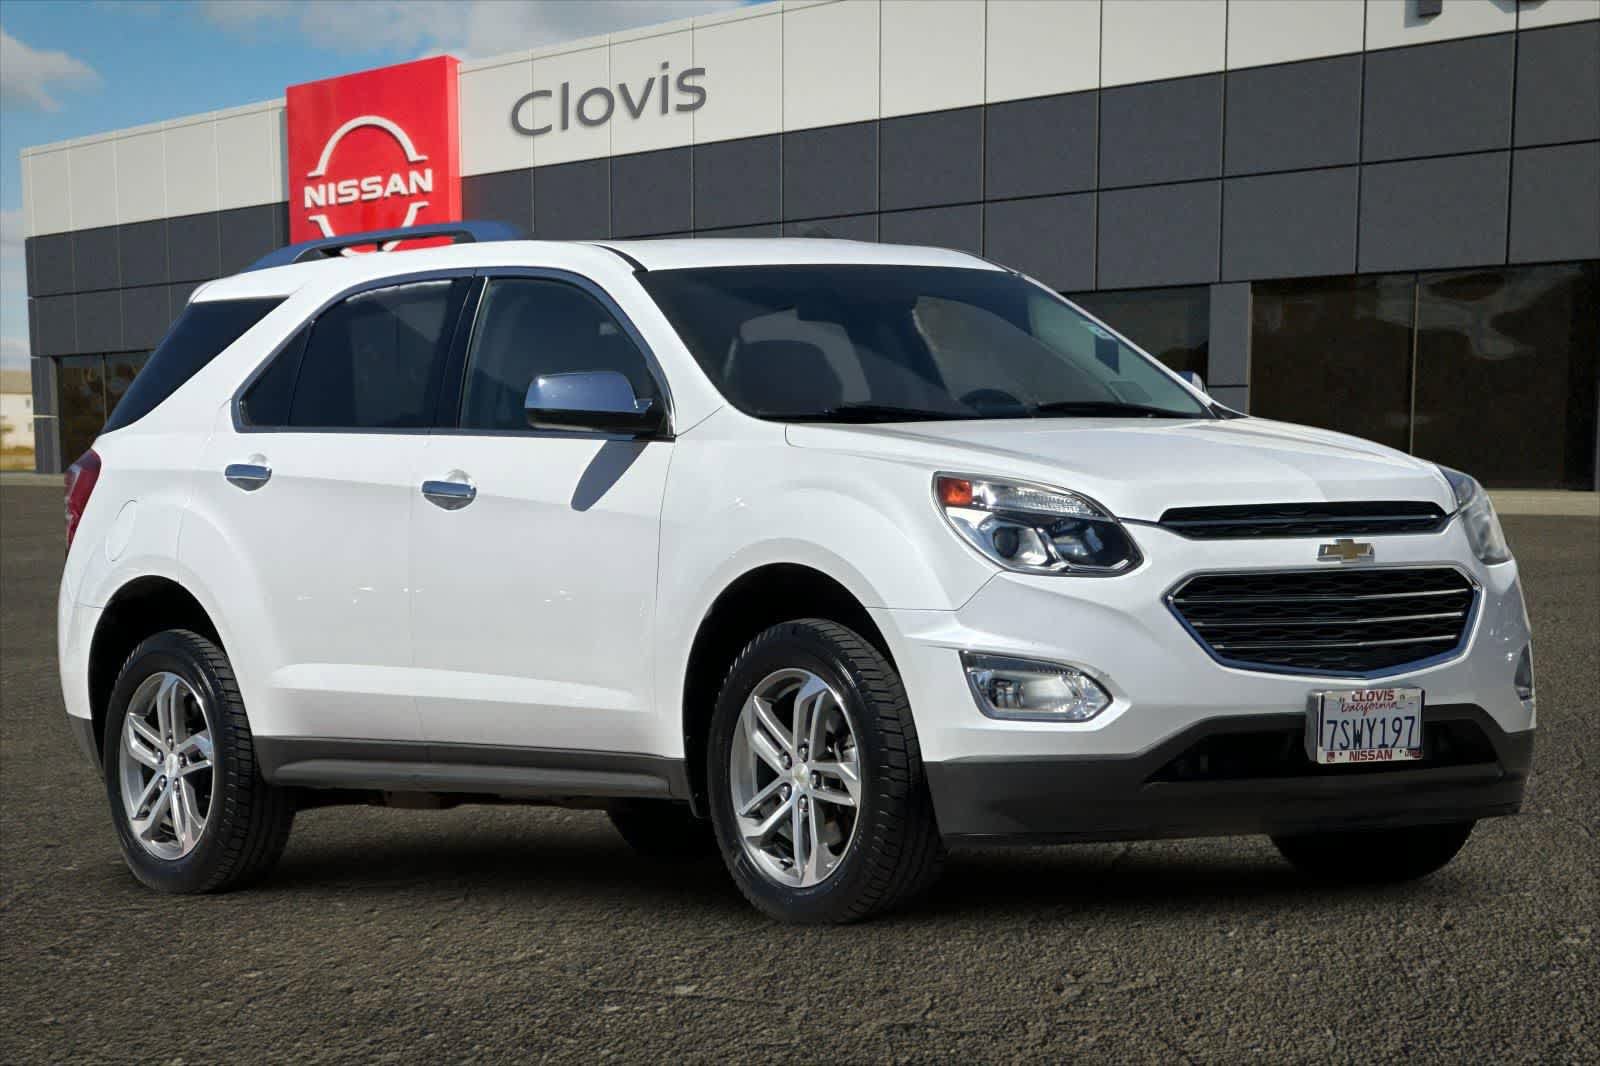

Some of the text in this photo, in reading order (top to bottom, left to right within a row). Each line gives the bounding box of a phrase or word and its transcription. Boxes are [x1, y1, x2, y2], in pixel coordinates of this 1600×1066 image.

[510, 62, 707, 136] Clovis
[304, 168, 433, 208] NISSAN
[1352, 690, 1395, 702] CLOVIS
[1341, 702, 1398, 716] California
[1326, 716, 1415, 751] 7SWY197
[1349, 749, 1393, 761] NISSAN
